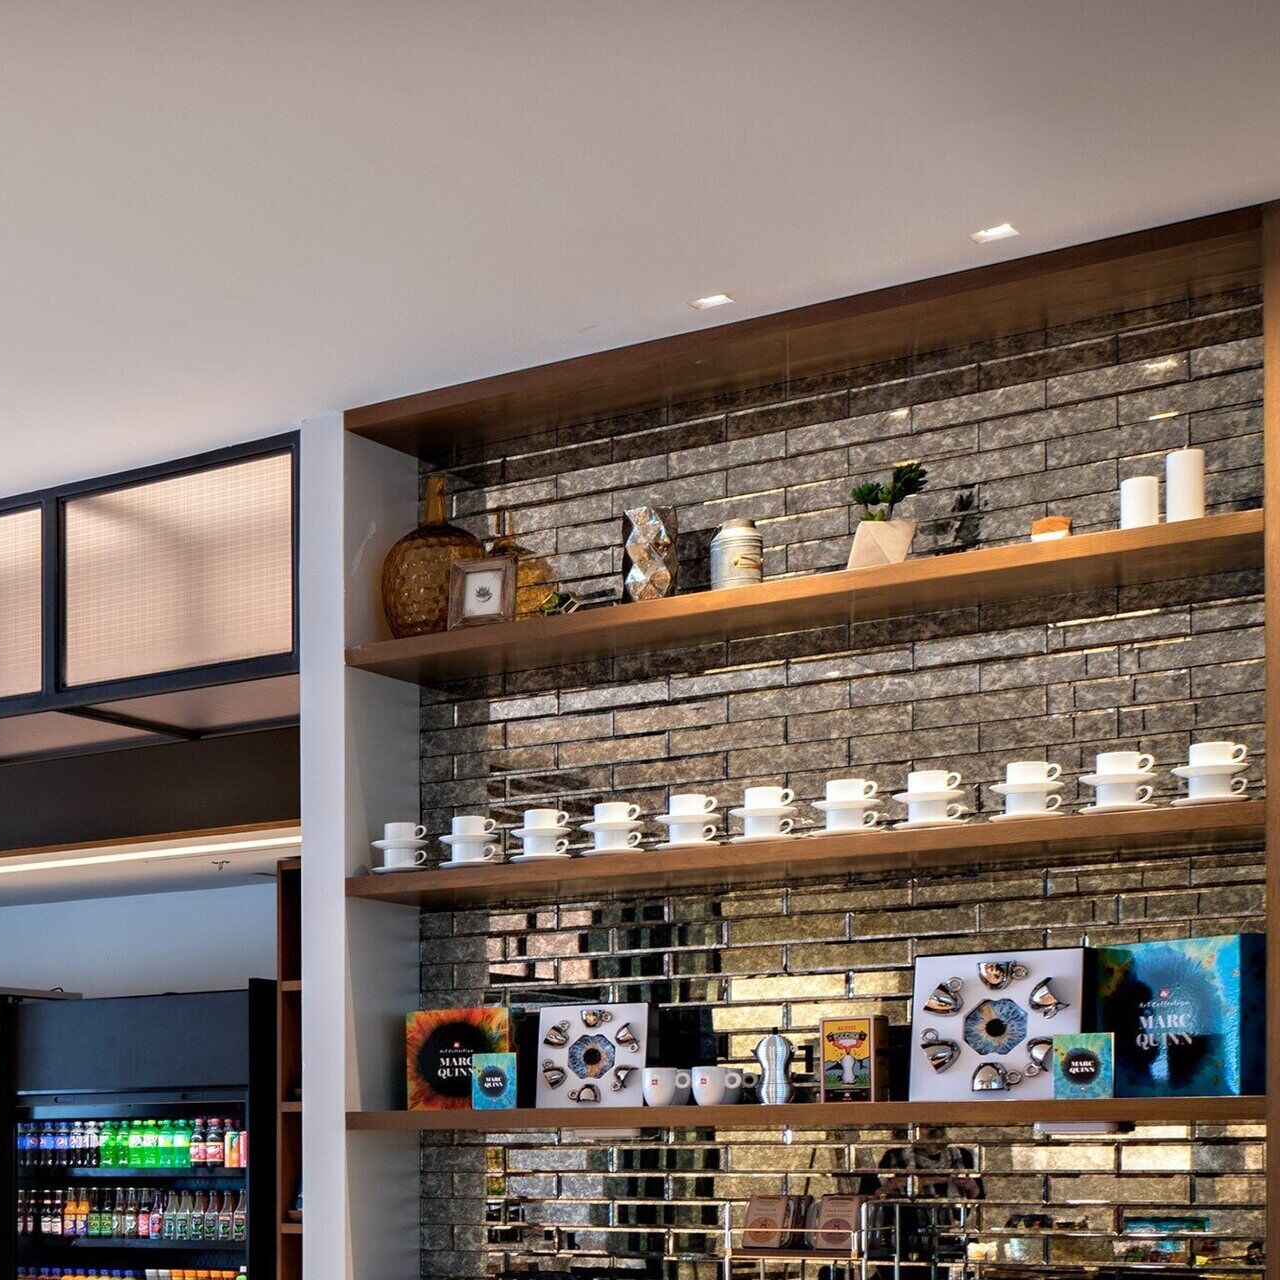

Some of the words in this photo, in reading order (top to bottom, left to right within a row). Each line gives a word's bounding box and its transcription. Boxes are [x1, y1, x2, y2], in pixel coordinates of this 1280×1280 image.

[1139, 1012, 1192, 1030] MARC
[1135, 1031, 1193, 1051] QUINN
[439, 1057, 473, 1067] MARC
